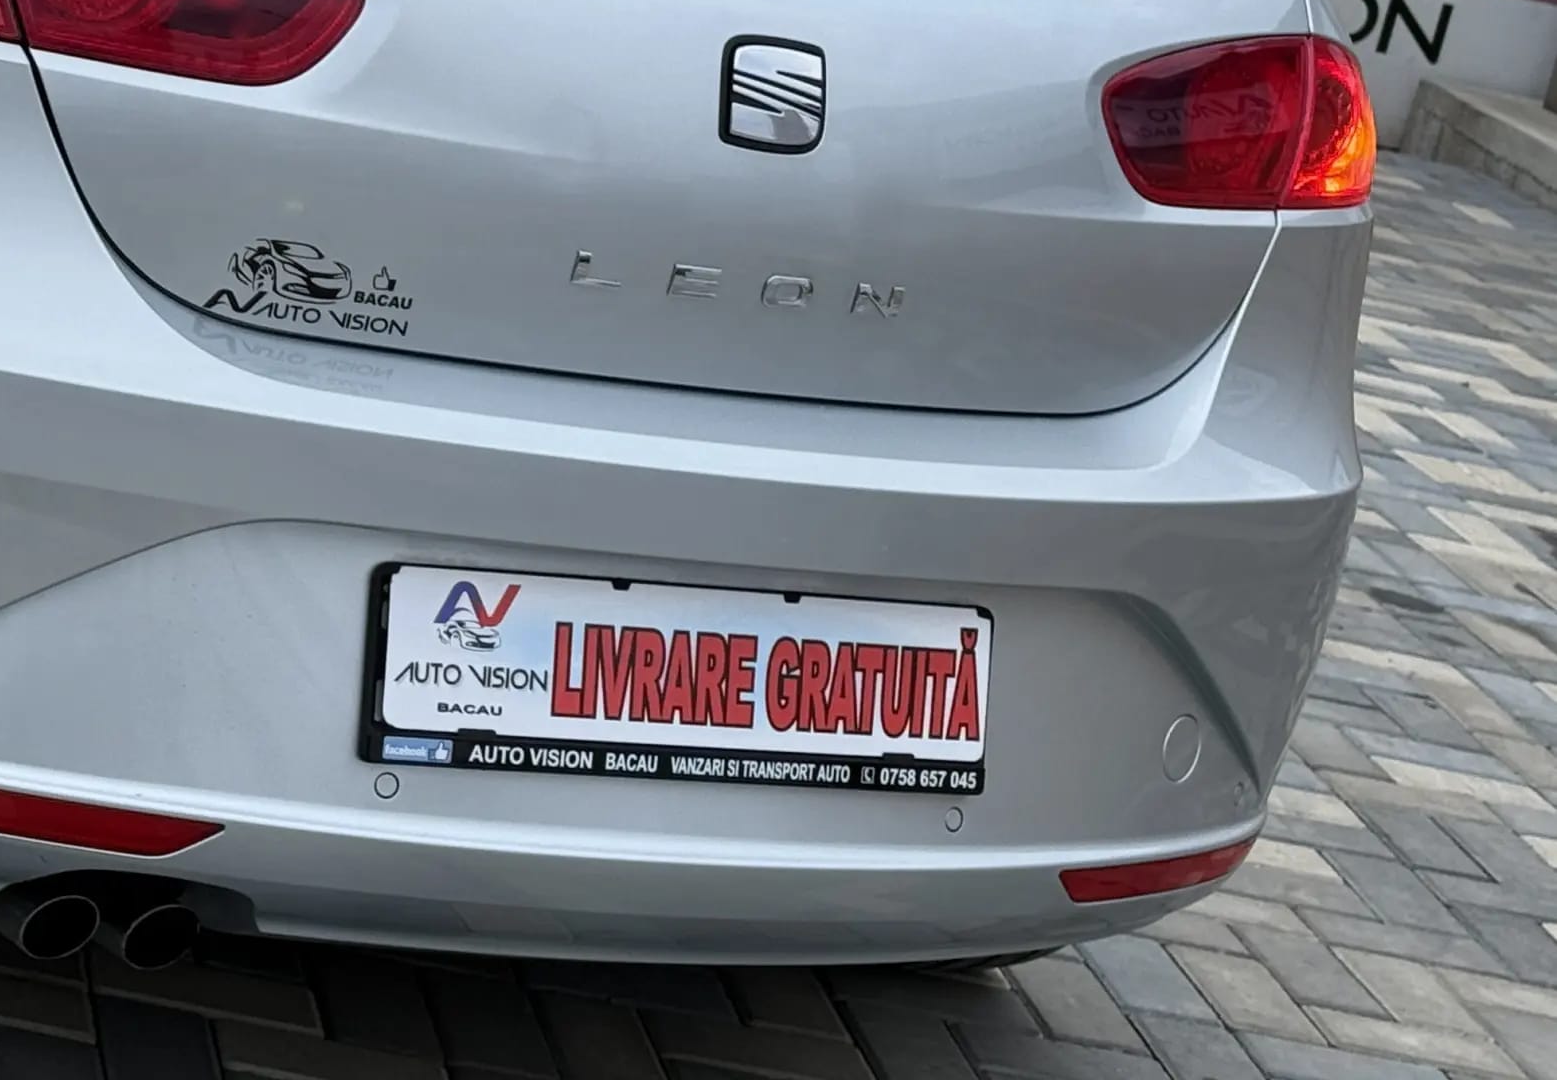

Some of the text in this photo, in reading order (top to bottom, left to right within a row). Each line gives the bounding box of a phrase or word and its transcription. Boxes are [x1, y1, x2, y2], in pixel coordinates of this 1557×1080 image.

[353, 290, 413, 310] BACAU
[570, 250, 906, 318] LEON
[252, 302, 409, 337] AUTO VISION
[394, 661, 549, 692] AUTO VISION
[551, 621, 980, 741] LIVRARE GRATUITĂ
[437, 702, 503, 716] BACAU
[469, 744, 977, 789] AUTO VISION BACAU VANZARI SI TRANSPORT AUTO 0758 657 045
